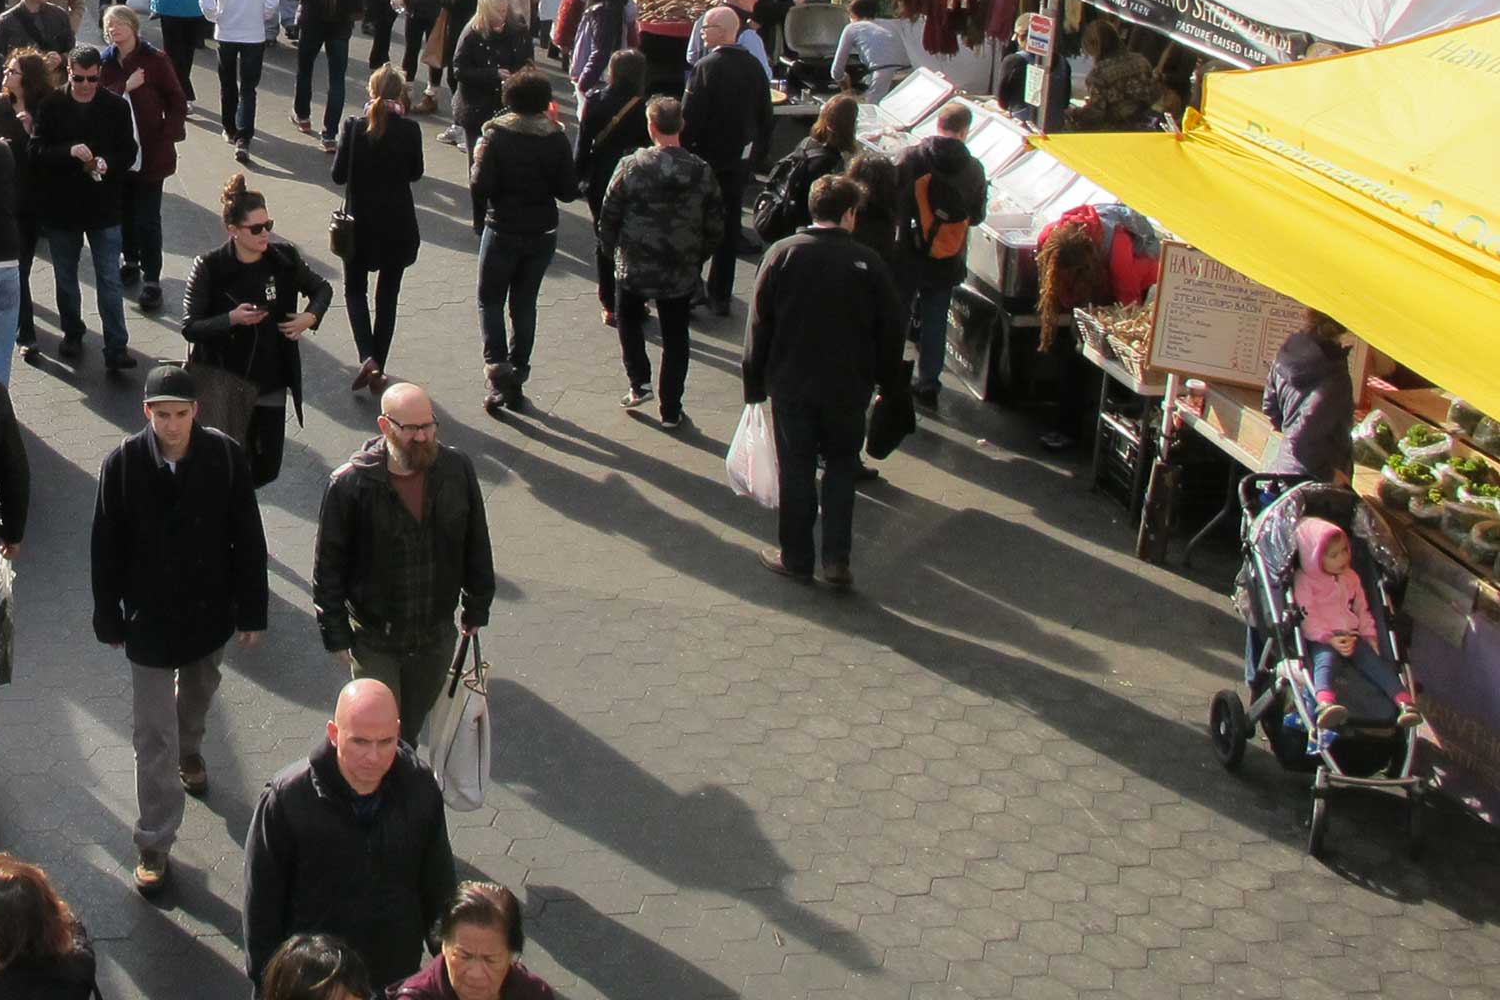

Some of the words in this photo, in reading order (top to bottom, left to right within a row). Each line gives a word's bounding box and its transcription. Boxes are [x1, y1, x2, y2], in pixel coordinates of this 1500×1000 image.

[1129, 0, 1150, 17] YARN
[1176, 20, 1211, 42] PASTURE
[1212, 35, 1242, 55] RAISED
[1243, 45, 1266, 65] LAMB
[1416, 200, 1444, 226] &
[1169, 254, 1252, 284] HAWTHOR
